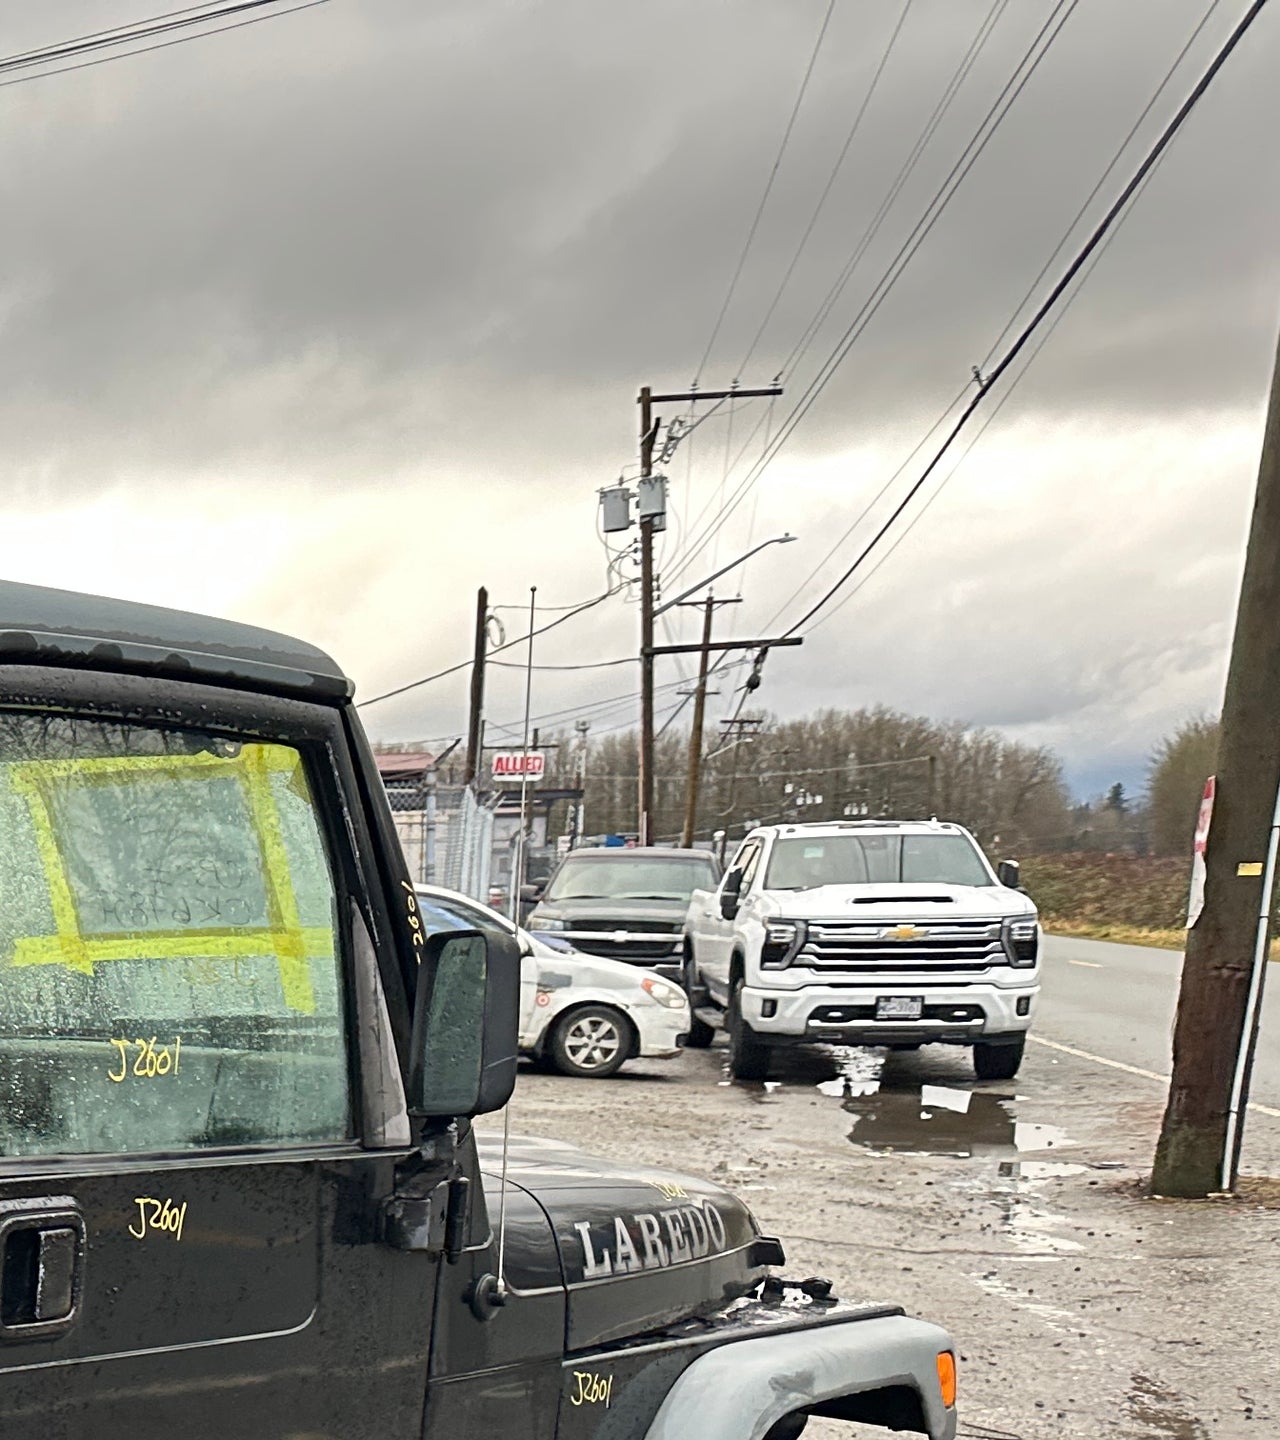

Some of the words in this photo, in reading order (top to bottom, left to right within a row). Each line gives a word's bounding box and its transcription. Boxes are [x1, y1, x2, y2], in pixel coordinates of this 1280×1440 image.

[400, 880, 424, 966] 2601
[108, 1036, 182, 1083] J2601
[128, 1197, 187, 1241] J2601
[574, 1201, 727, 1280] LAREDO
[570, 1370, 613, 1409] J2601
